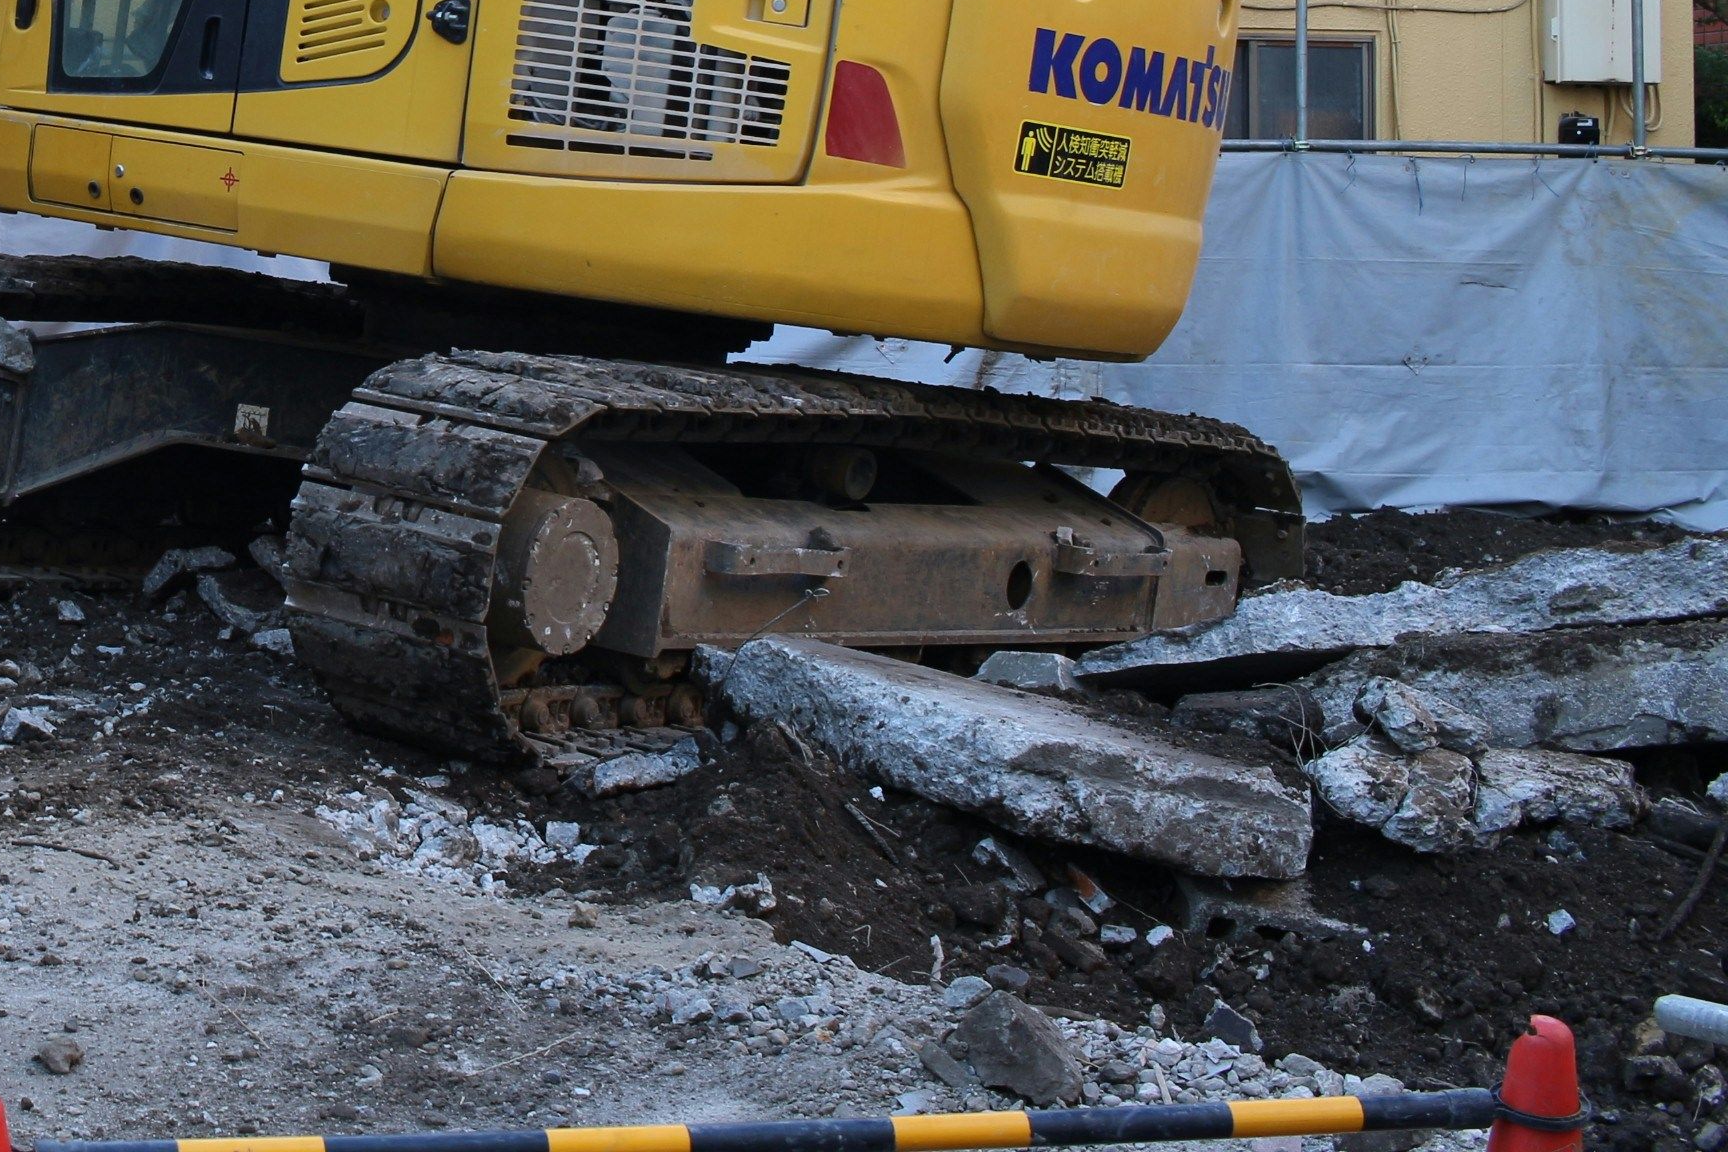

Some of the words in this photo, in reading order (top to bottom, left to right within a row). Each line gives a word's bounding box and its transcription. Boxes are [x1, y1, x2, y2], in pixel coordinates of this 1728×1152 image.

[1057, 133, 1128, 161] 人検知衝突軽減
[1053, 155, 1124, 184] システム搭載機
